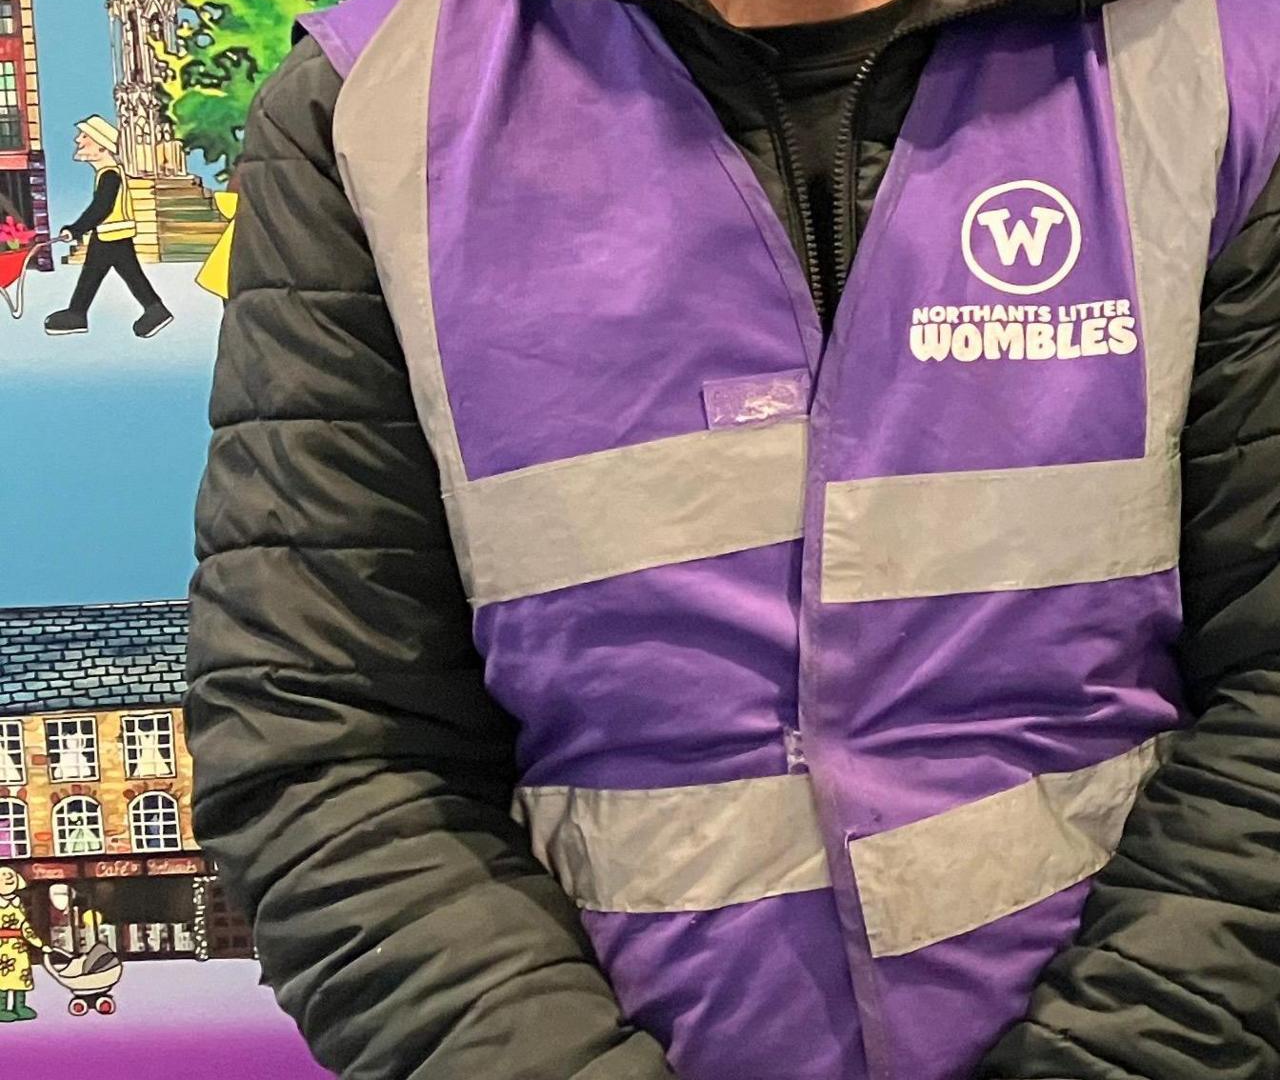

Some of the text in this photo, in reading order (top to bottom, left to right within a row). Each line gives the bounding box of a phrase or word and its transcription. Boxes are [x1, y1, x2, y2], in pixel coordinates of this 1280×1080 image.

[976, 206, 1065, 267] W
[912, 299, 1131, 324] NORTHANTS LITTER
[909, 316, 1138, 362] WOMBLES
